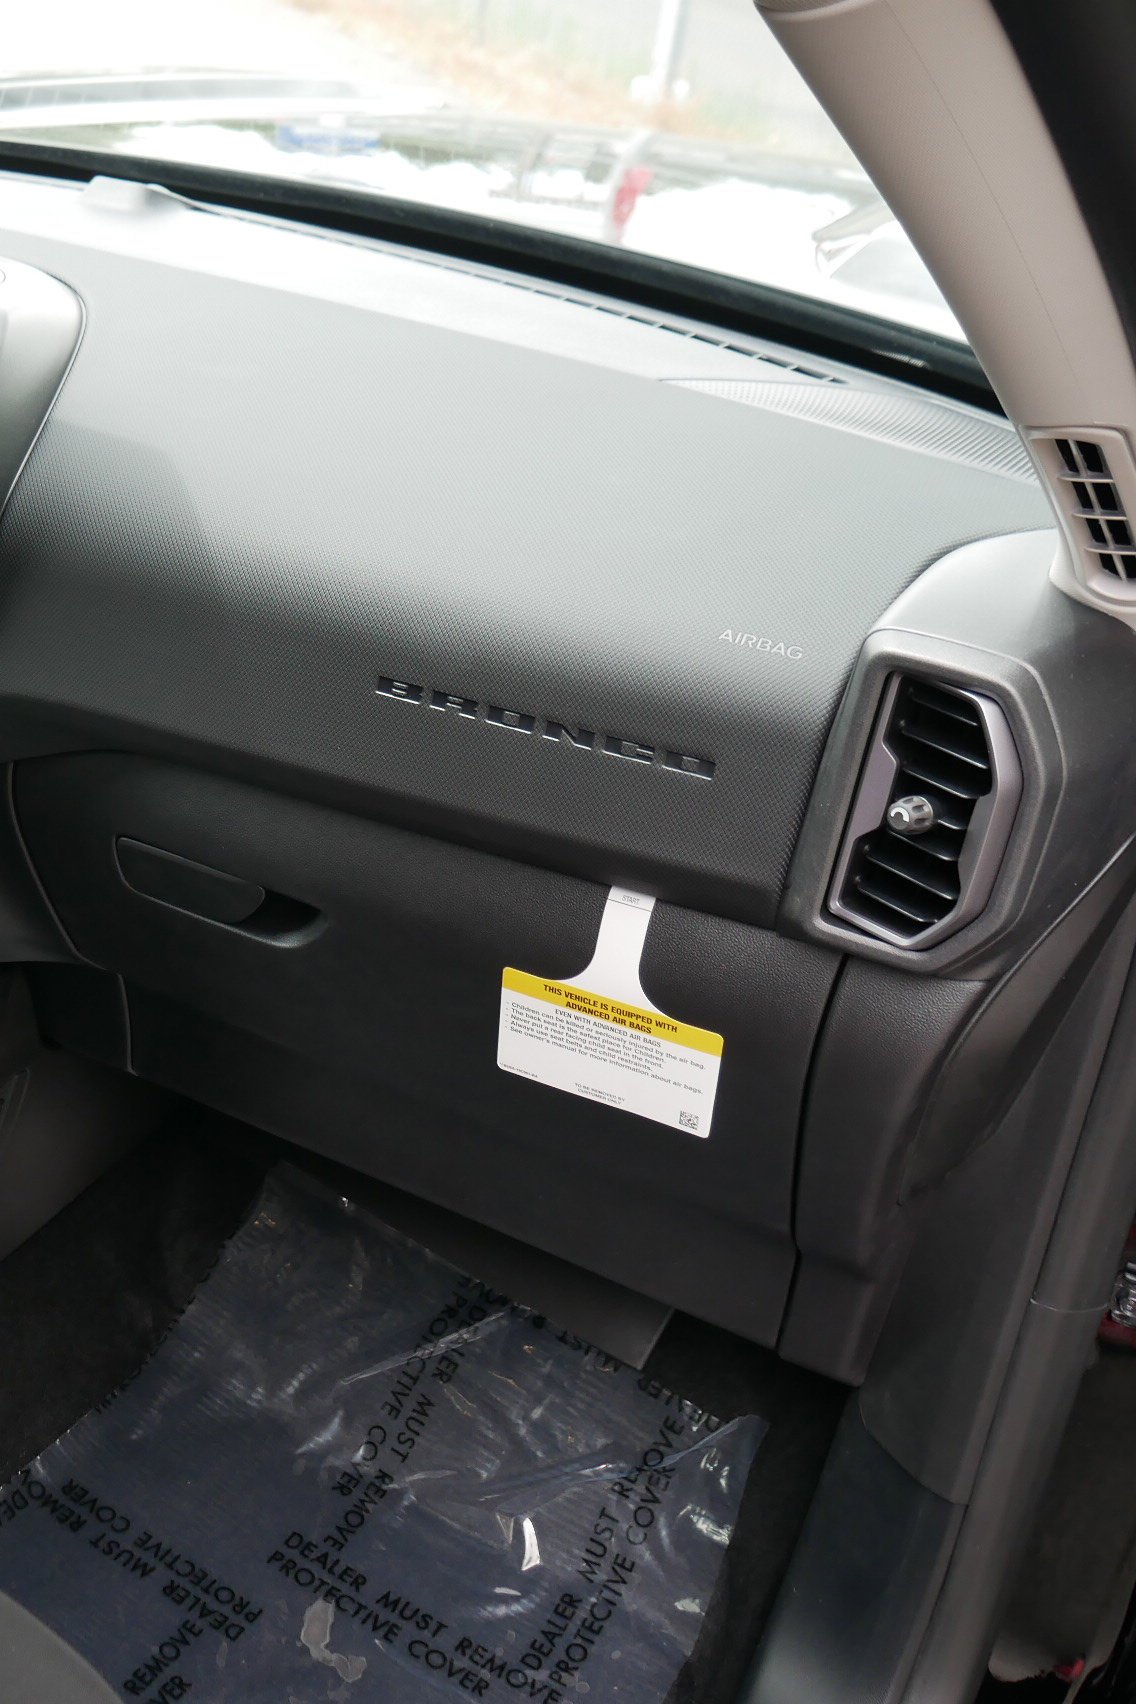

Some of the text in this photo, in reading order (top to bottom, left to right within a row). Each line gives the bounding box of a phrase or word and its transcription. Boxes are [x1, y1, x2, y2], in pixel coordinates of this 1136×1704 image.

[719, 628, 803, 660] AIRBAG
[375, 676, 716, 781] BRONCO
[510, 1013, 530, 1025] Never
[531, 1021, 543, 1030] put
[550, 1028, 563, 1036] rear
[565, 1032, 586, 1044] facing
[588, 1039, 605, 1049] child
[607, 1045, 622, 1055] seat
[631, 1053, 643, 1062] the
[644, 1058, 663, 1069] front.
[511, 1007, 523, 1016] The
[525, 1012, 541, 1022] back
[543, 1018, 557, 1027] seat
[566, 1026, 577, 1034] the
[579, 1030, 600, 1041] safest
[601, 1037, 620, 1049] place
[622, 1044, 632, 1052] for
[634, 1048, 666, 1063] Children.
[511, 1001, 540, 1015] Children
[541, 1012, 553, 1020] can
[565, 1019, 584, 1030] killed
[595, 1029, 626, 1045] seriously
[628, 1040, 653, 1053] injured
[655, 1048, 663, 1057] by
[666, 1052, 677, 1060] the
[678, 1056, 687, 1064] air
[690, 1060, 706, 1070] bag.
[543, 983, 677, 1033] THIS VEHICLE IS EQUIPPED WITH
[555, 1008, 661, 1048] EVEN WITH ADVANCED AIR BAGS
[565, 1000, 652, 1034] ADVANCED AIR BAGS
[509, 1025, 703, 1095] See owner's manual for more information about air bags.
[510, 1019, 653, 1072] Always use seat belts and child restraints.
[323, 1304, 487, 1551] DLER MUST REMOVE
[332, 1290, 468, 1496] PROTCTIVE COVER
[61, 1478, 262, 1623] PROTECTIVE COVER
[89, 1533, 155, 1578] MUST
[549, 1466, 676, 1687] PROTECTIVE COVER
[162, 1579, 245, 1642] DEALER
[267, 1550, 489, 1697] PROTECTIVE COVER
[284, 1531, 562, 1704] DEALER MUST REMOVE
[520, 1592, 582, 1671] DEALER
[577, 1507, 619, 1584] MUST
[123, 1620, 203, 1695] REMOVE
